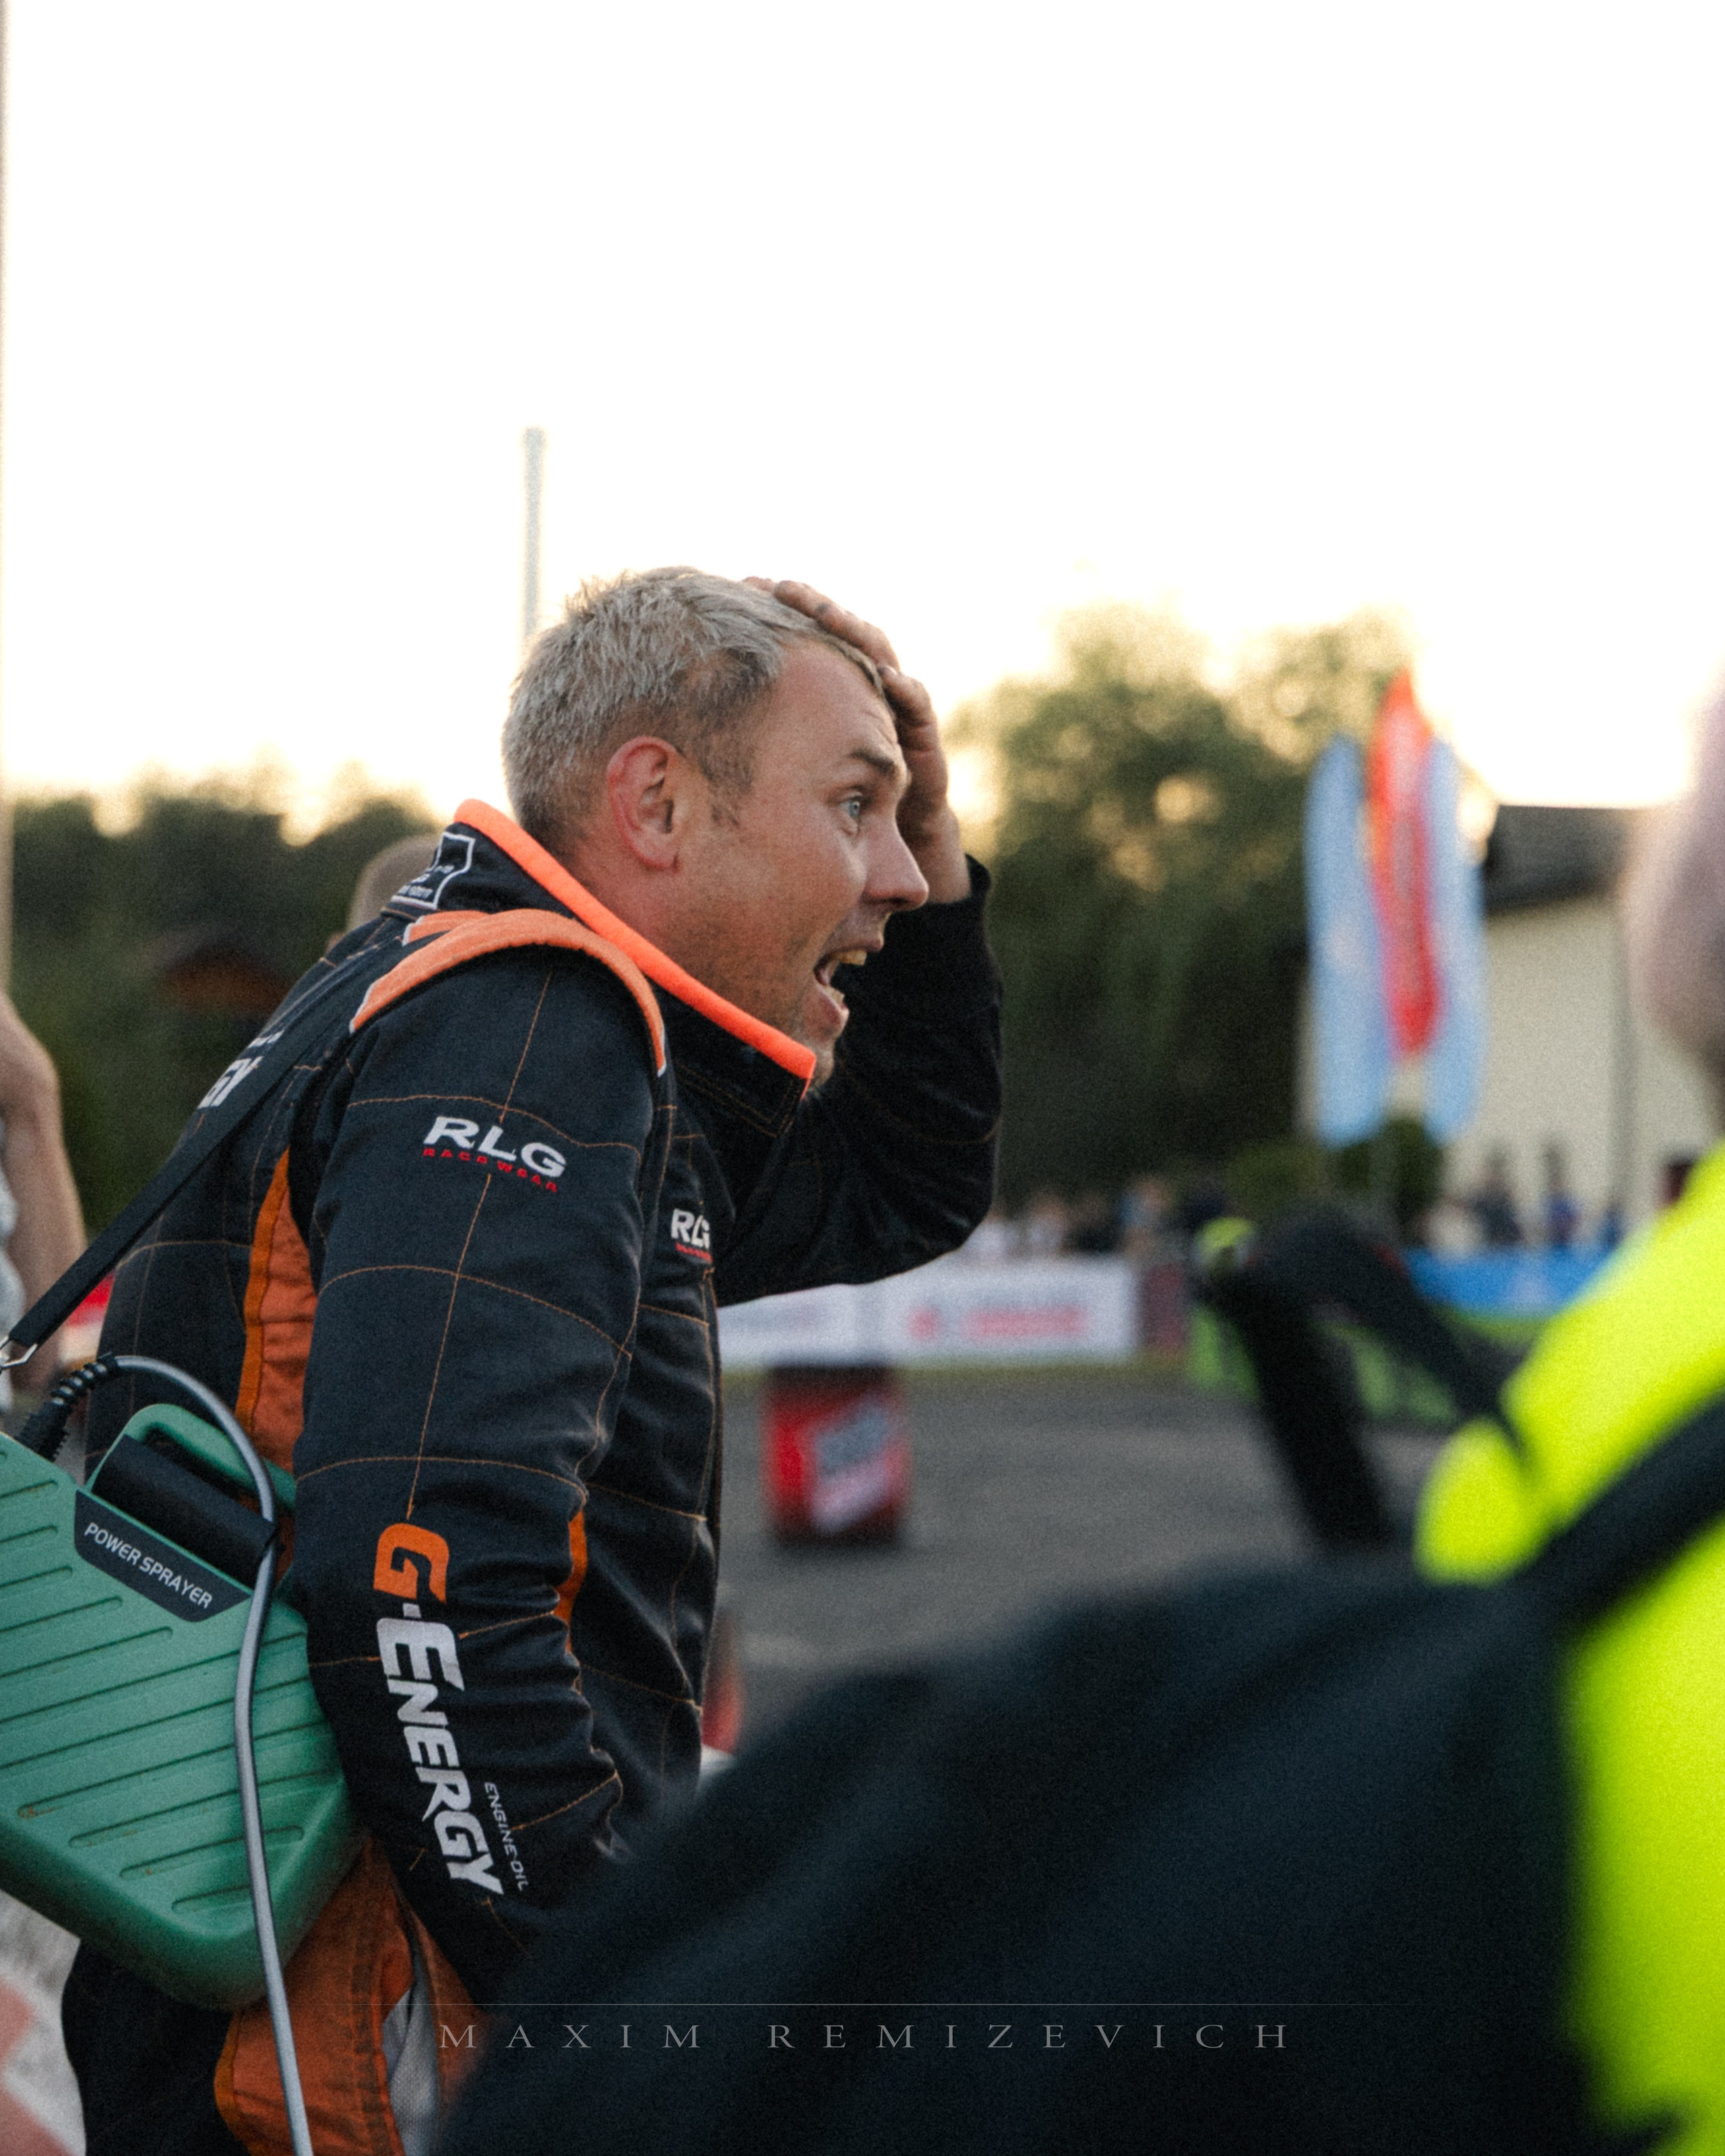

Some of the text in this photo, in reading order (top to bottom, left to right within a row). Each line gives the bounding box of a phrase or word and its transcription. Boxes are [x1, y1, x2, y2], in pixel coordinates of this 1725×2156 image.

[423, 1116, 567, 1178] RLG
[84, 1522, 213, 1609] POWER SPRAYER
[484, 1782, 528, 1892] ENGINE OIL
